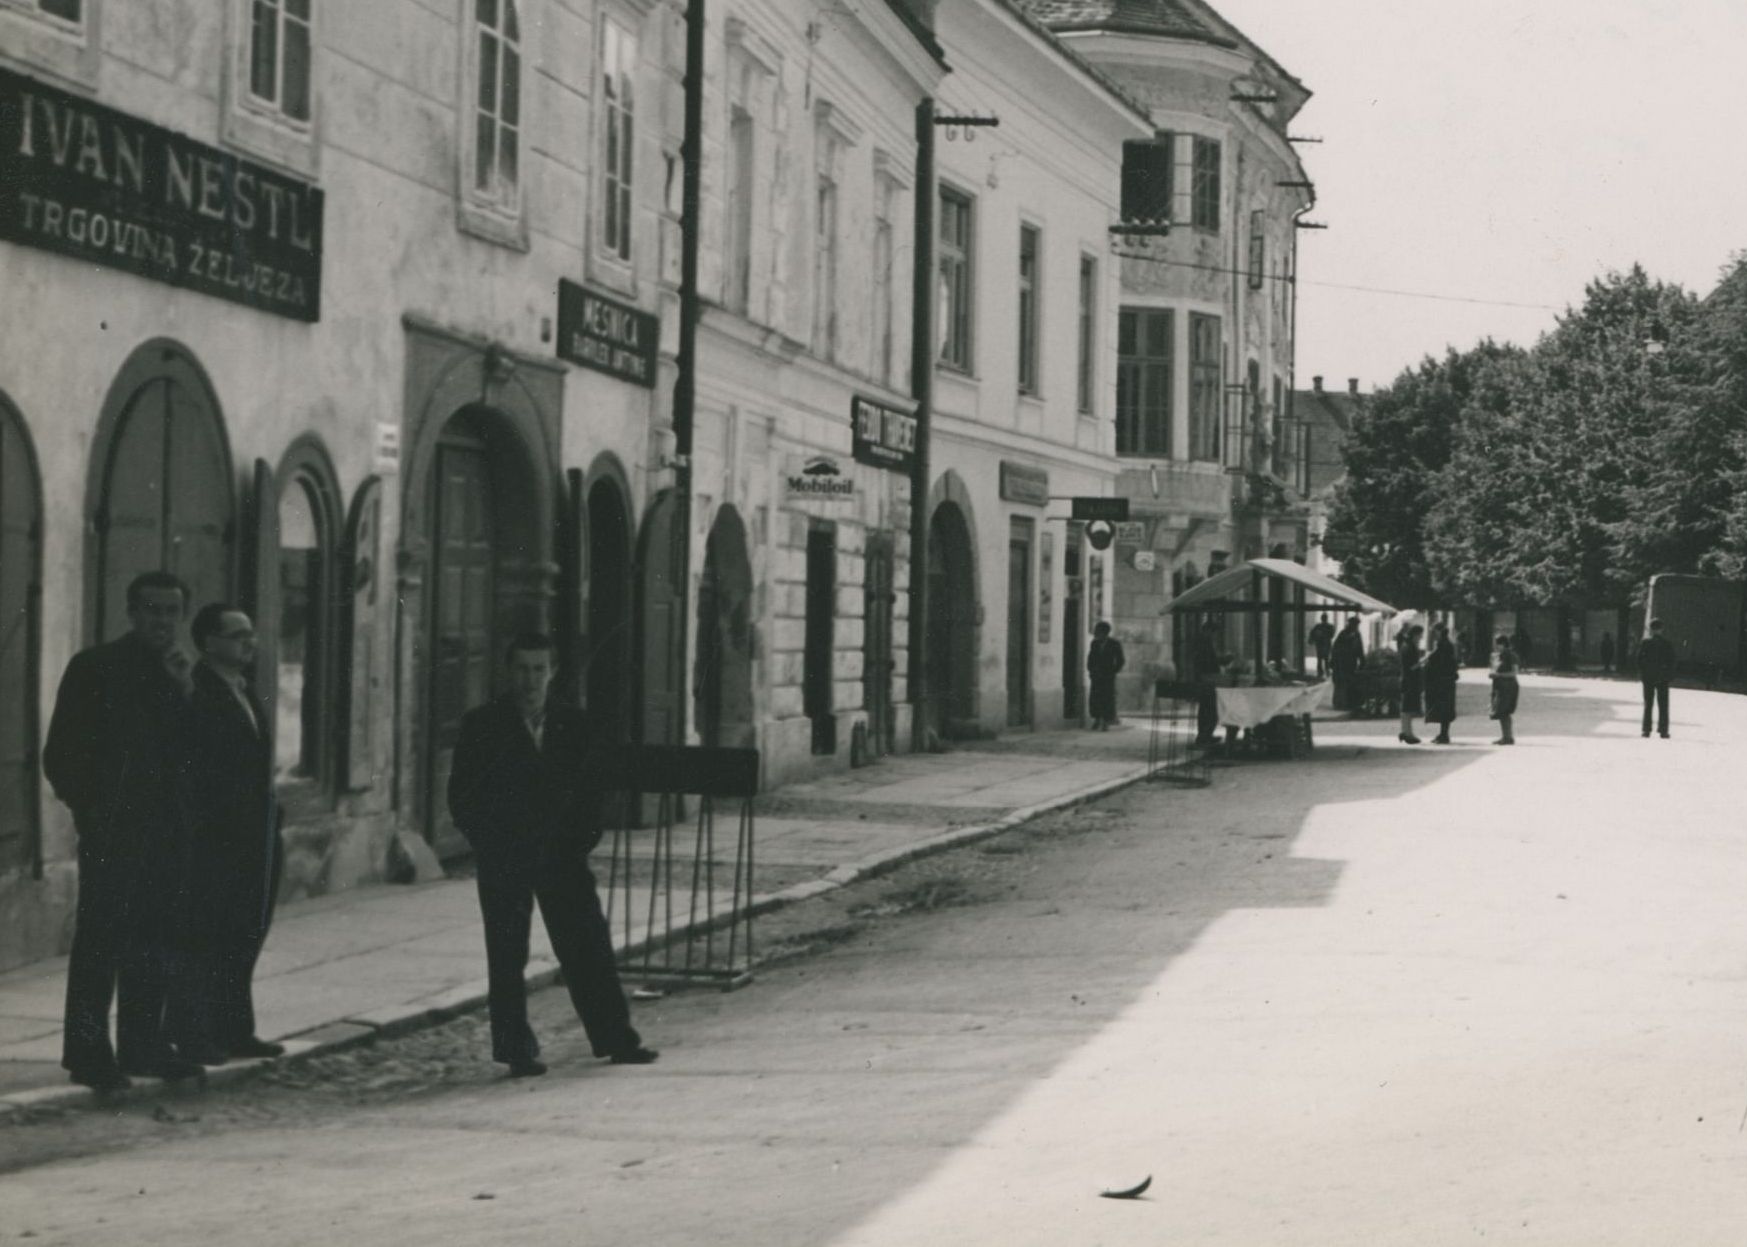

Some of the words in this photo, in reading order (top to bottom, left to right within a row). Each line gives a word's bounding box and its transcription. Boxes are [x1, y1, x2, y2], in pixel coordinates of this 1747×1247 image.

[19, 92, 143, 194] IVAN
[165, 143, 313, 250] NESTL
[787, 476, 853, 494] Mobiloil
